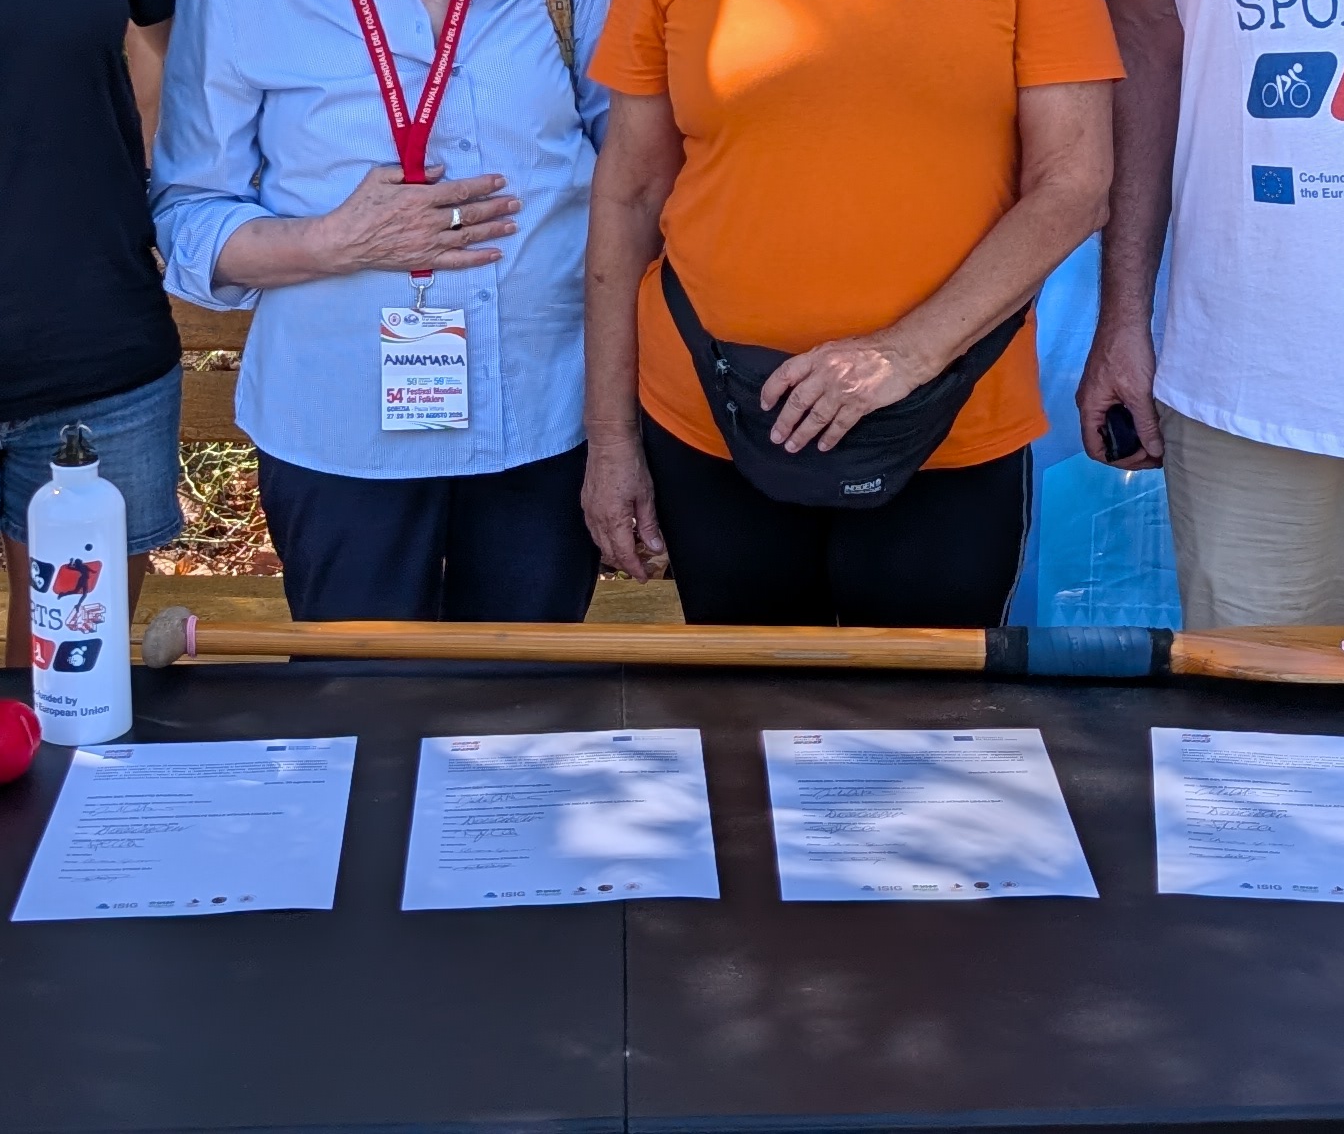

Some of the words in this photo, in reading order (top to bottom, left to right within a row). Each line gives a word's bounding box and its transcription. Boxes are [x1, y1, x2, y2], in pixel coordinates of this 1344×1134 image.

[419, 84, 439, 124] FESTIVAL
[432, 40, 452, 86] MONDIALE
[445, 25, 457, 43] DEL
[1300, 186, 1318, 199] the
[383, 353, 466, 367] ANNAMARIA
[65, 696, 79, 707] by
[80, 705, 110, 717] Union
[877, 884, 903, 892] ISIG
